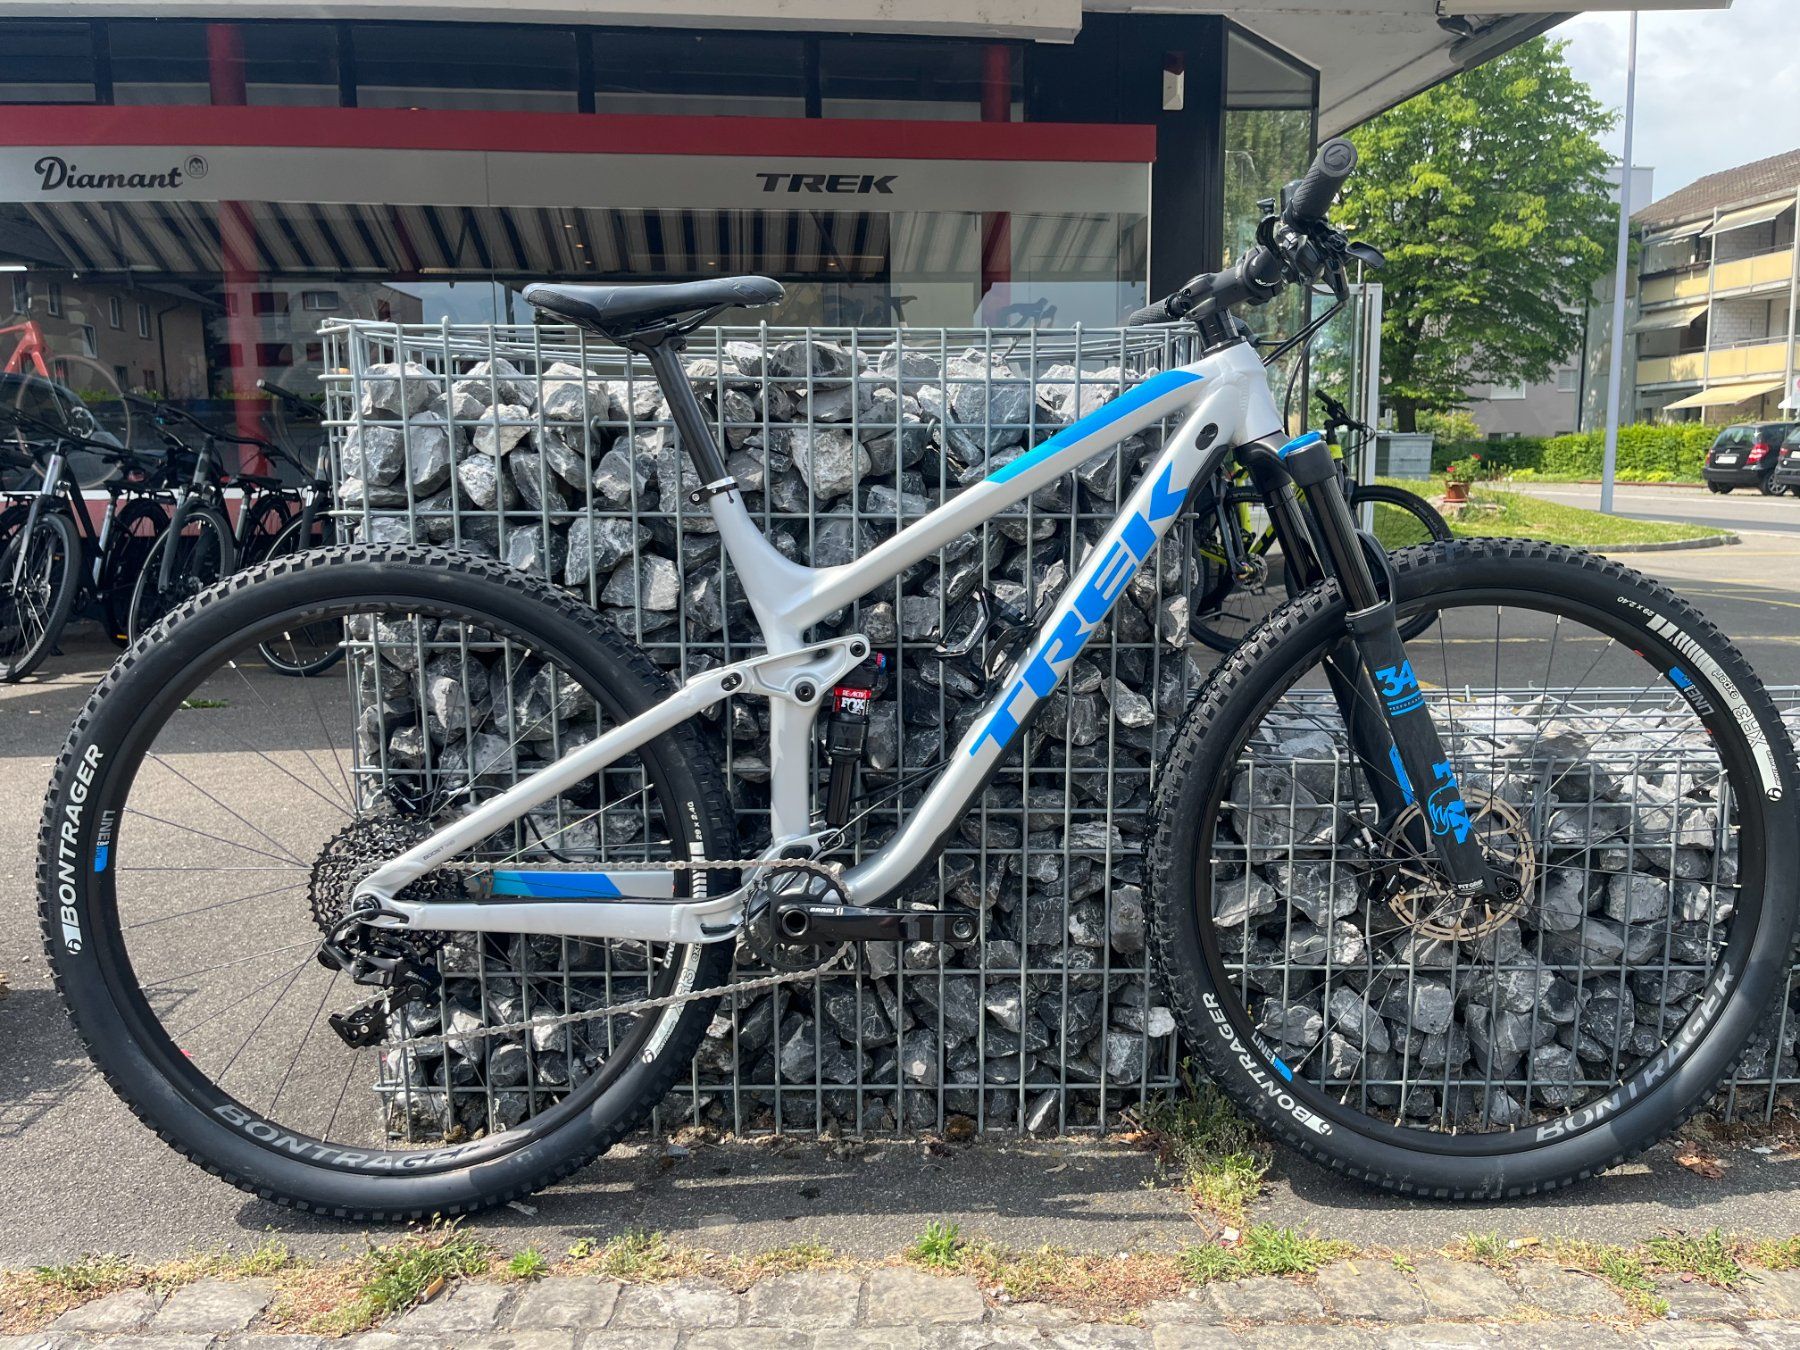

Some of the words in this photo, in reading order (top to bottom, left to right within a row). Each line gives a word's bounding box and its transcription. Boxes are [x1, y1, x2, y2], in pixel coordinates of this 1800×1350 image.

[34, 156, 183, 191] Diamant
[756, 173, 899, 194] TREK
[969, 460, 1189, 757] TREK
[1375, 659, 1418, 697] 34
[1711, 669, 1740, 700] expert
[841, 696, 865, 715] FOX
[1687, 689, 1716, 716] LINE
[1732, 703, 1768, 749] XR3
[58, 743, 104, 928] BONTRAGER
[98, 809, 116, 841] LINE
[1202, 992, 1312, 1123] BONTRAGER
[1251, 1031, 1275, 1061] LINE
